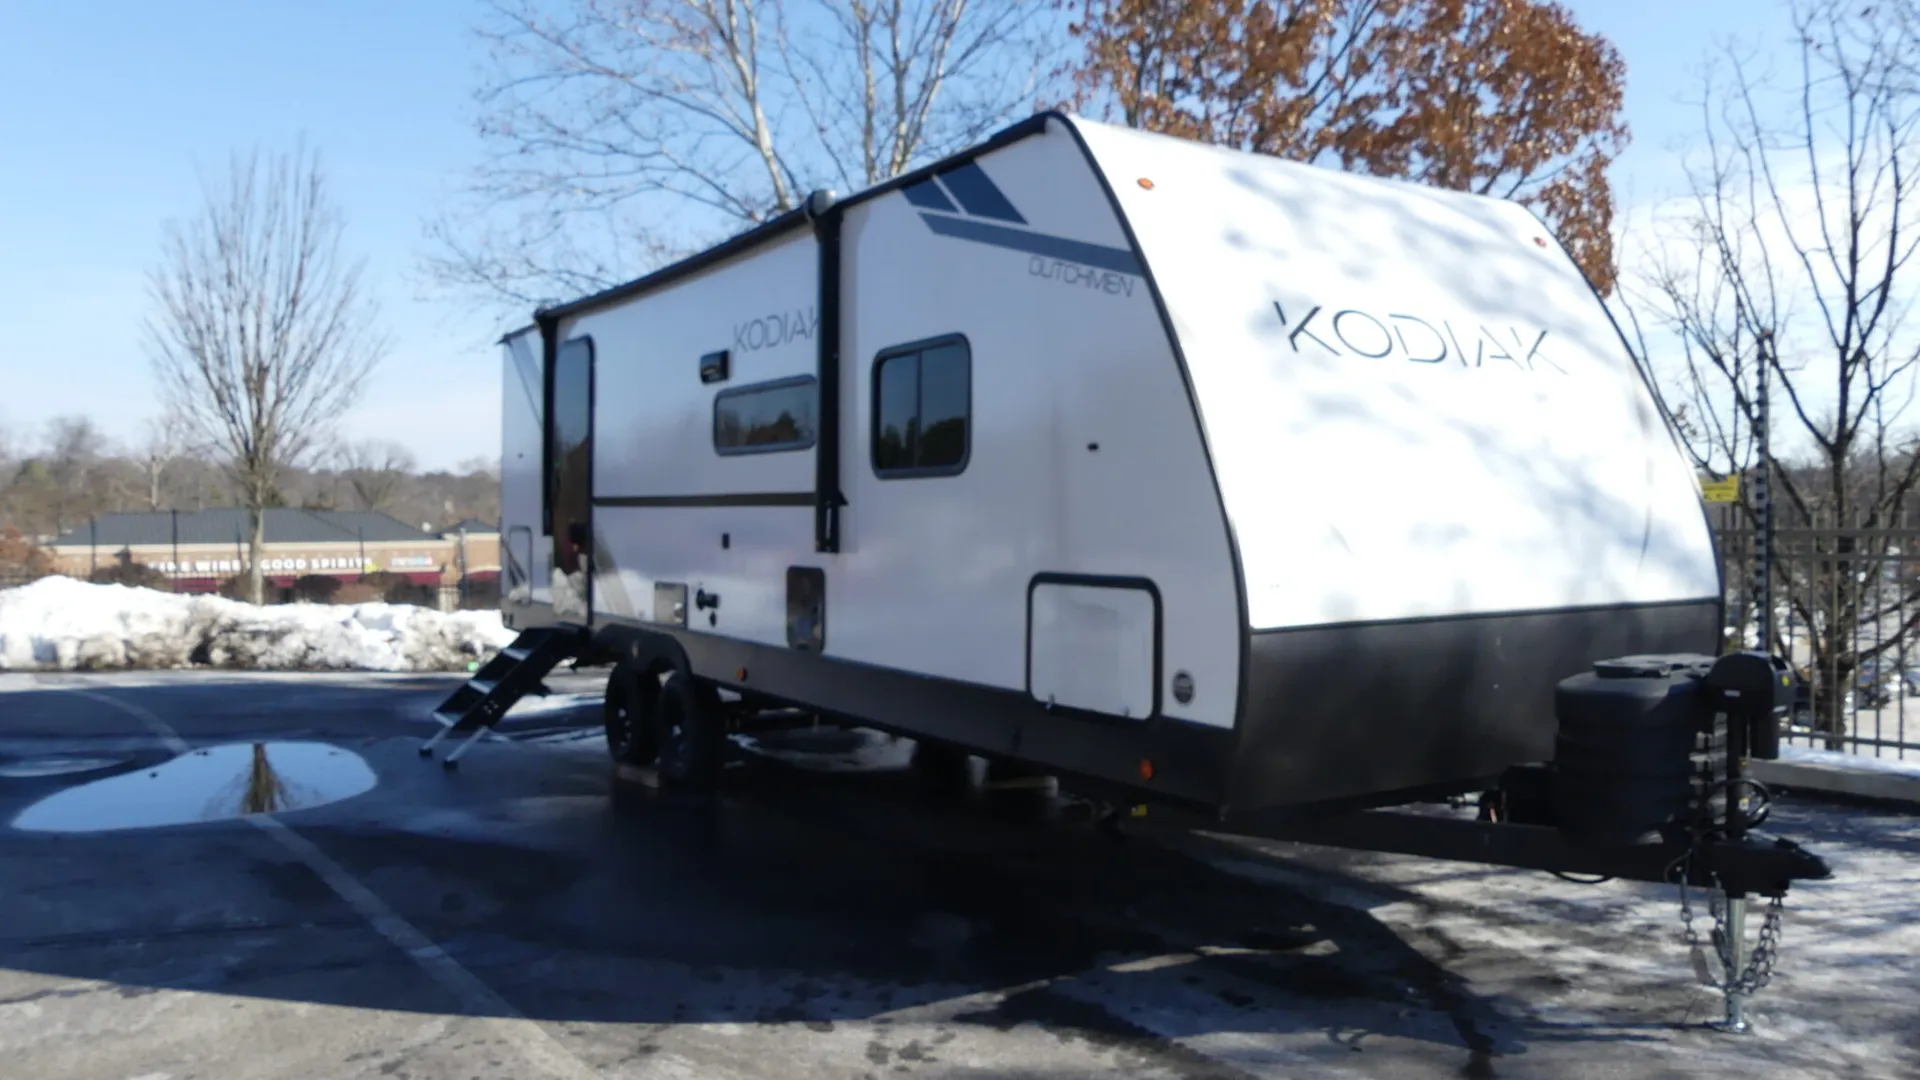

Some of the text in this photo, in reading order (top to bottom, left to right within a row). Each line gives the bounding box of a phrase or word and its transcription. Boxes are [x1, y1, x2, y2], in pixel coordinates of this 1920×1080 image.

[1028, 256, 1136, 298] DUTCHMEN
[1273, 300, 1568, 375] KODIAK
[260, 559, 307, 570] GOOD
